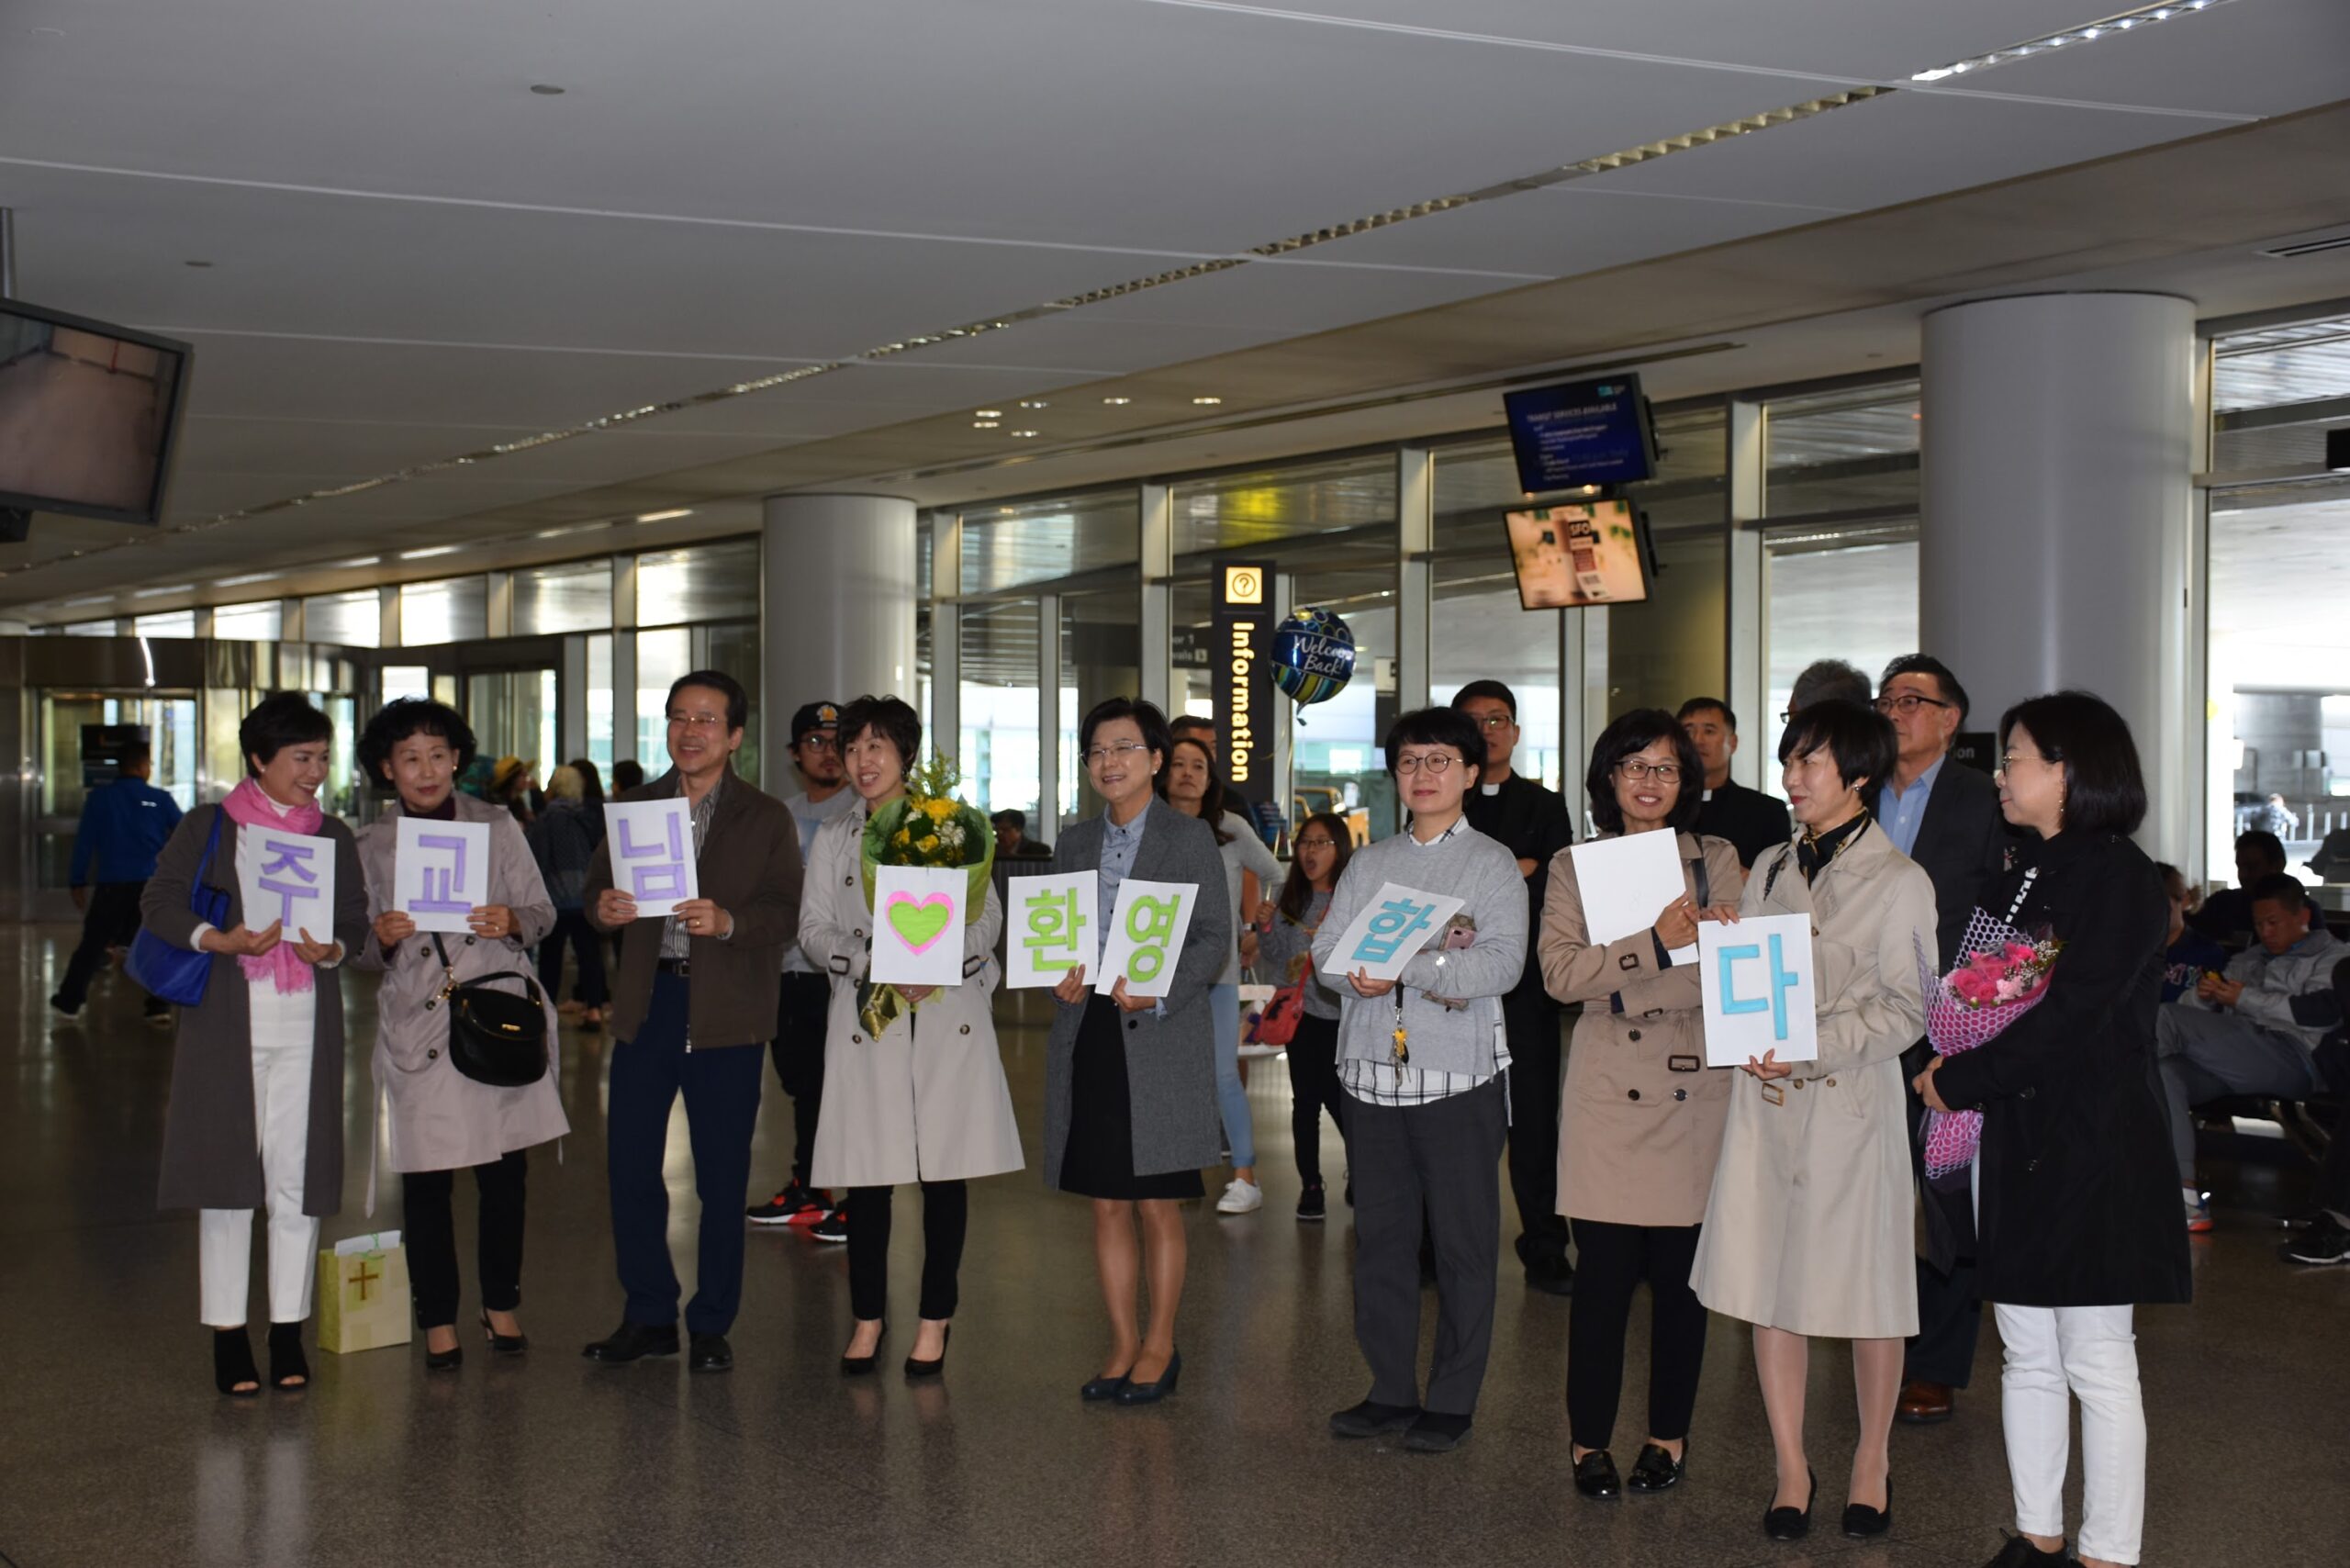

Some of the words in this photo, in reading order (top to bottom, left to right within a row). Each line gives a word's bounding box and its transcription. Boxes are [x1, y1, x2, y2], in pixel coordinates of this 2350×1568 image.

[1570, 522, 1590, 536] SFO
[1232, 622, 1255, 782] Information
[1304, 655, 1346, 676] Back!
[259, 839, 319, 927] 주
[408, 834, 473, 913] 교
[618, 812, 688, 902] 님
[1024, 887, 1087, 971] 환
[1125, 894, 1181, 983] 영
[1351, 897, 1437, 964] 합
[1718, 934, 1799, 1040] 다
